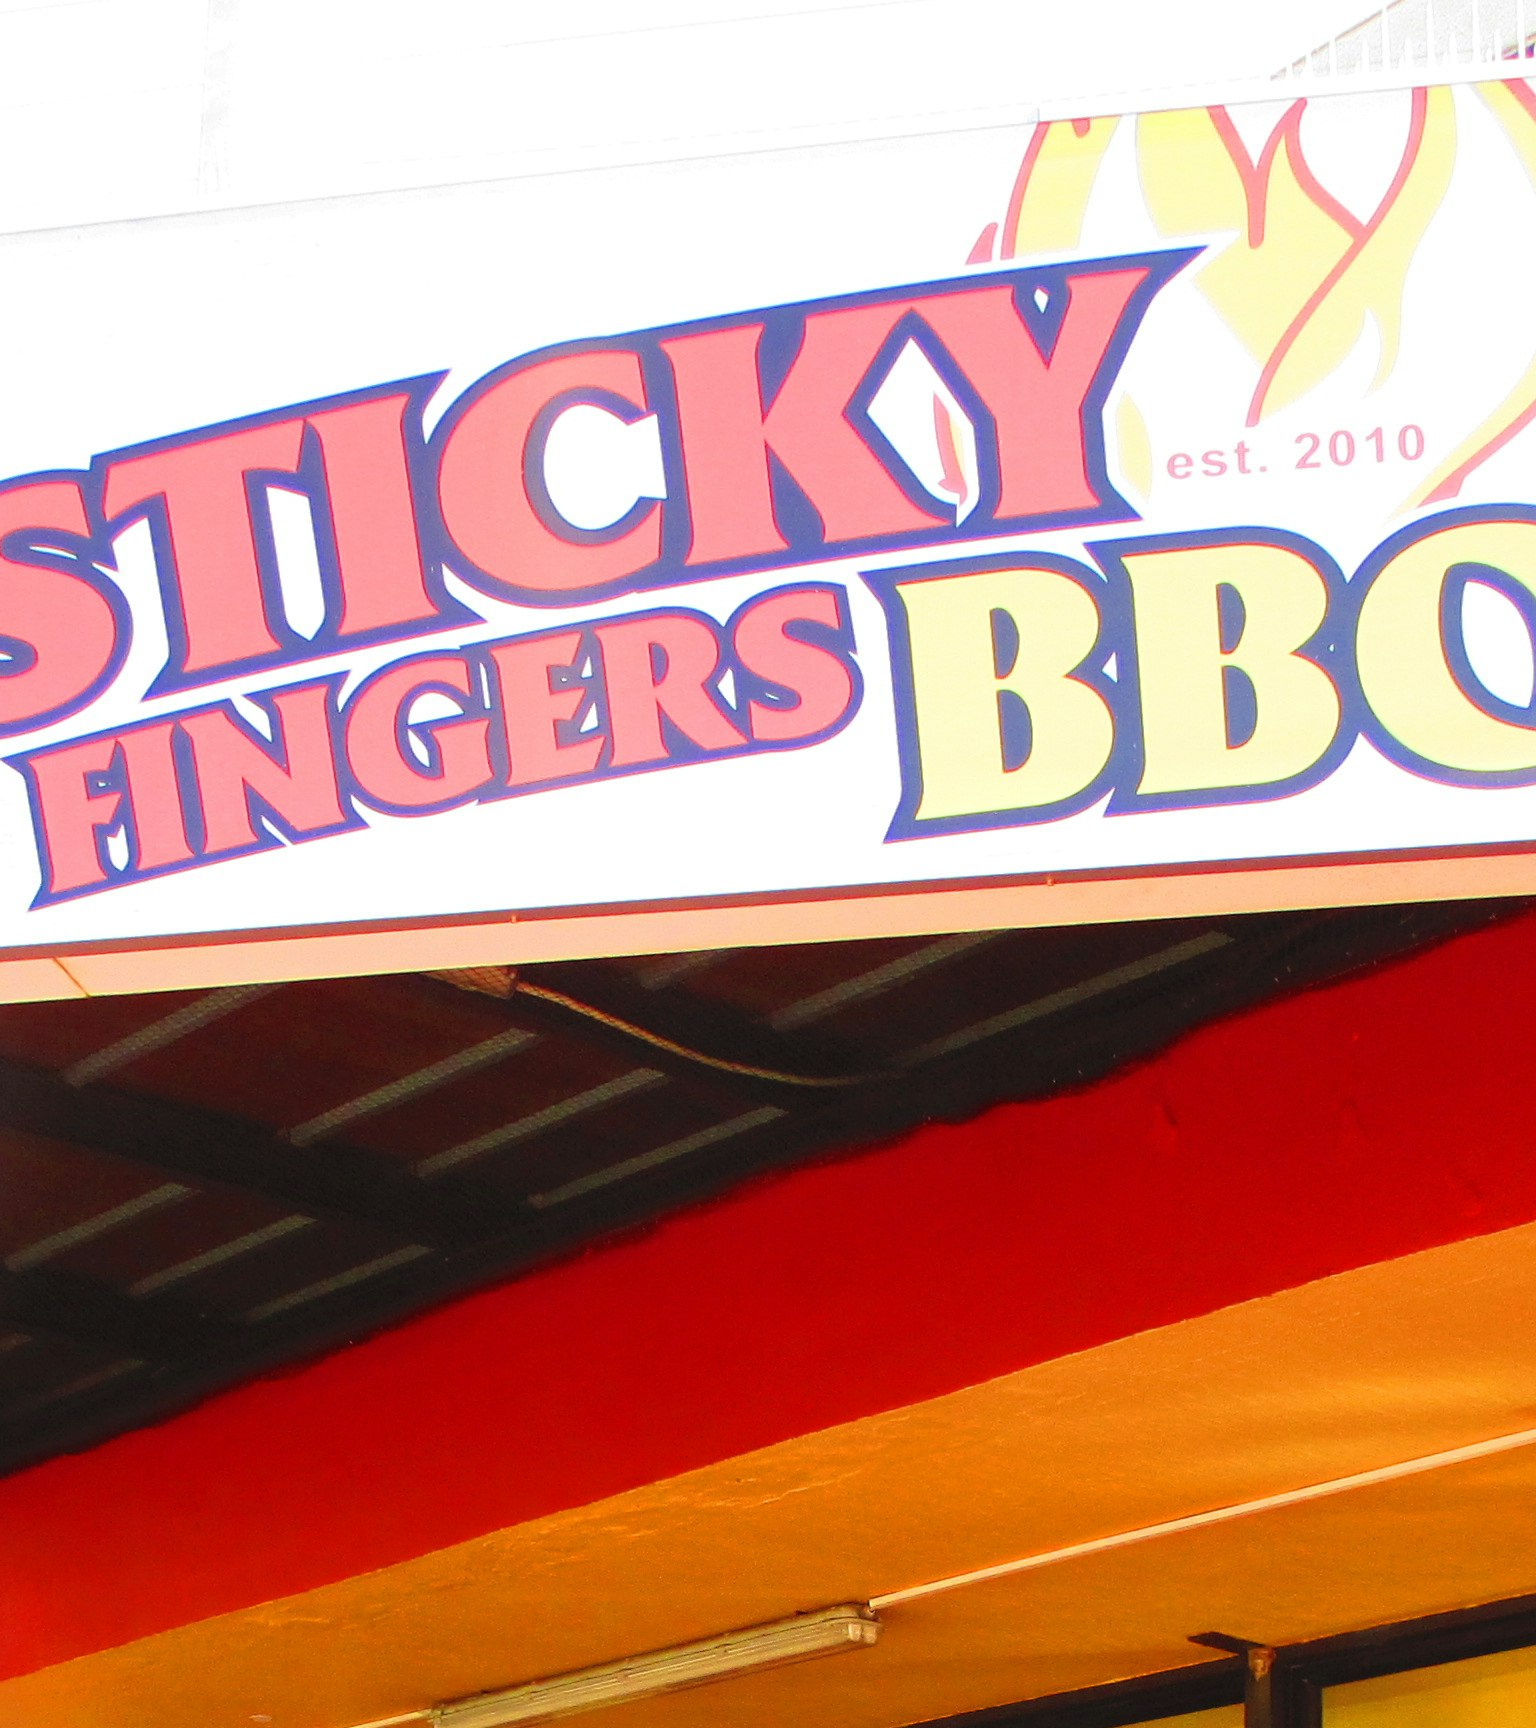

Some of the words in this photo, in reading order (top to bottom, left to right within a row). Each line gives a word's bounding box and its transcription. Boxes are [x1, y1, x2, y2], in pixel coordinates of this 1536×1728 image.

[1166, 440, 1267, 480] est.
[1294, 424, 1425, 470] 2010
[1, 581, 865, 911] FINGERS
